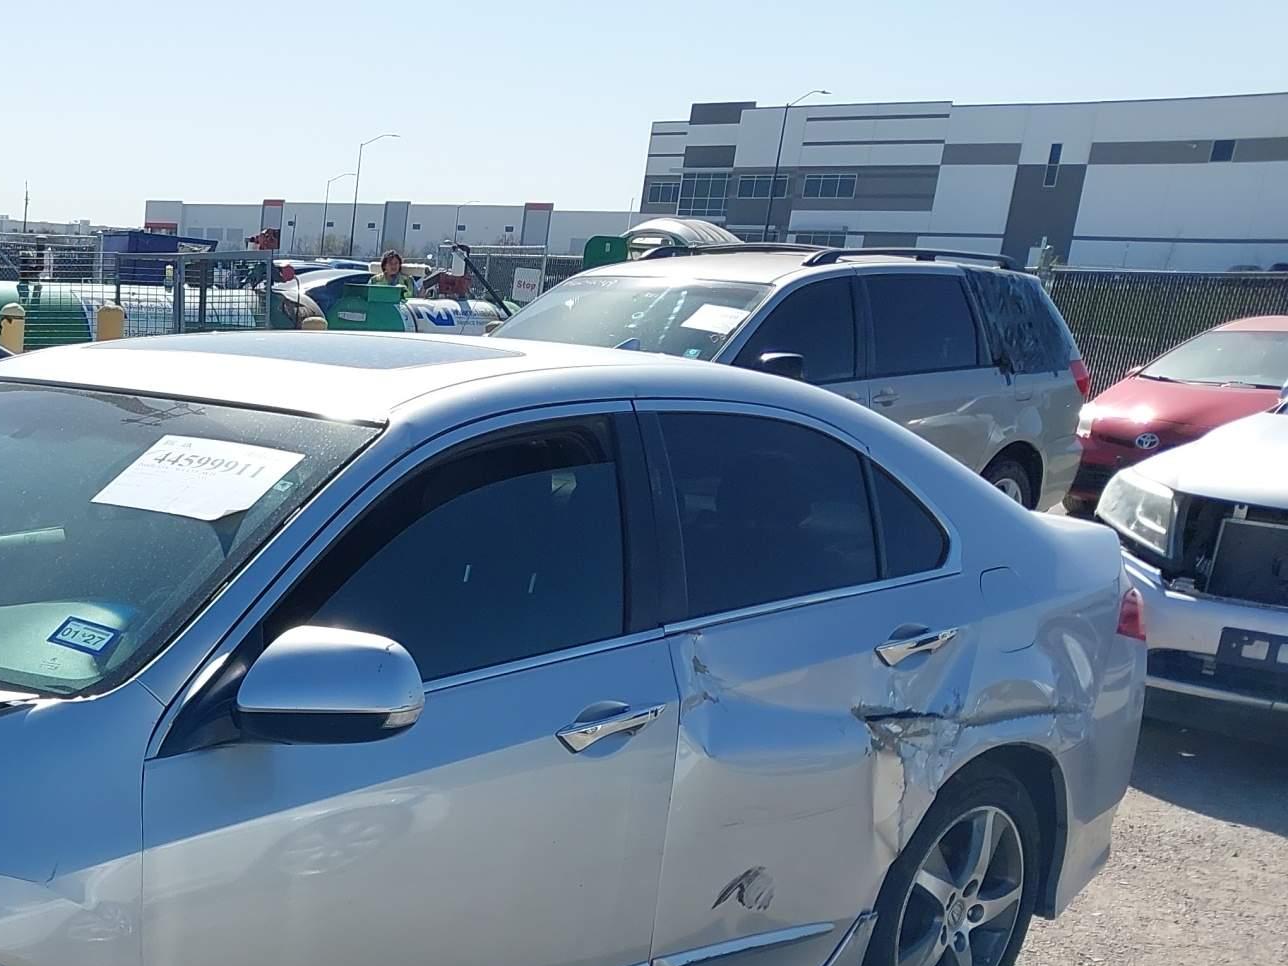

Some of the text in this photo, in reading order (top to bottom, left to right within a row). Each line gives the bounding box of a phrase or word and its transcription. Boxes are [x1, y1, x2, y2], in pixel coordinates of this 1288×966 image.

[516, 279, 537, 291] Stop
[154, 451, 265, 479] 44599911
[82, 632, 105, 646] 27
